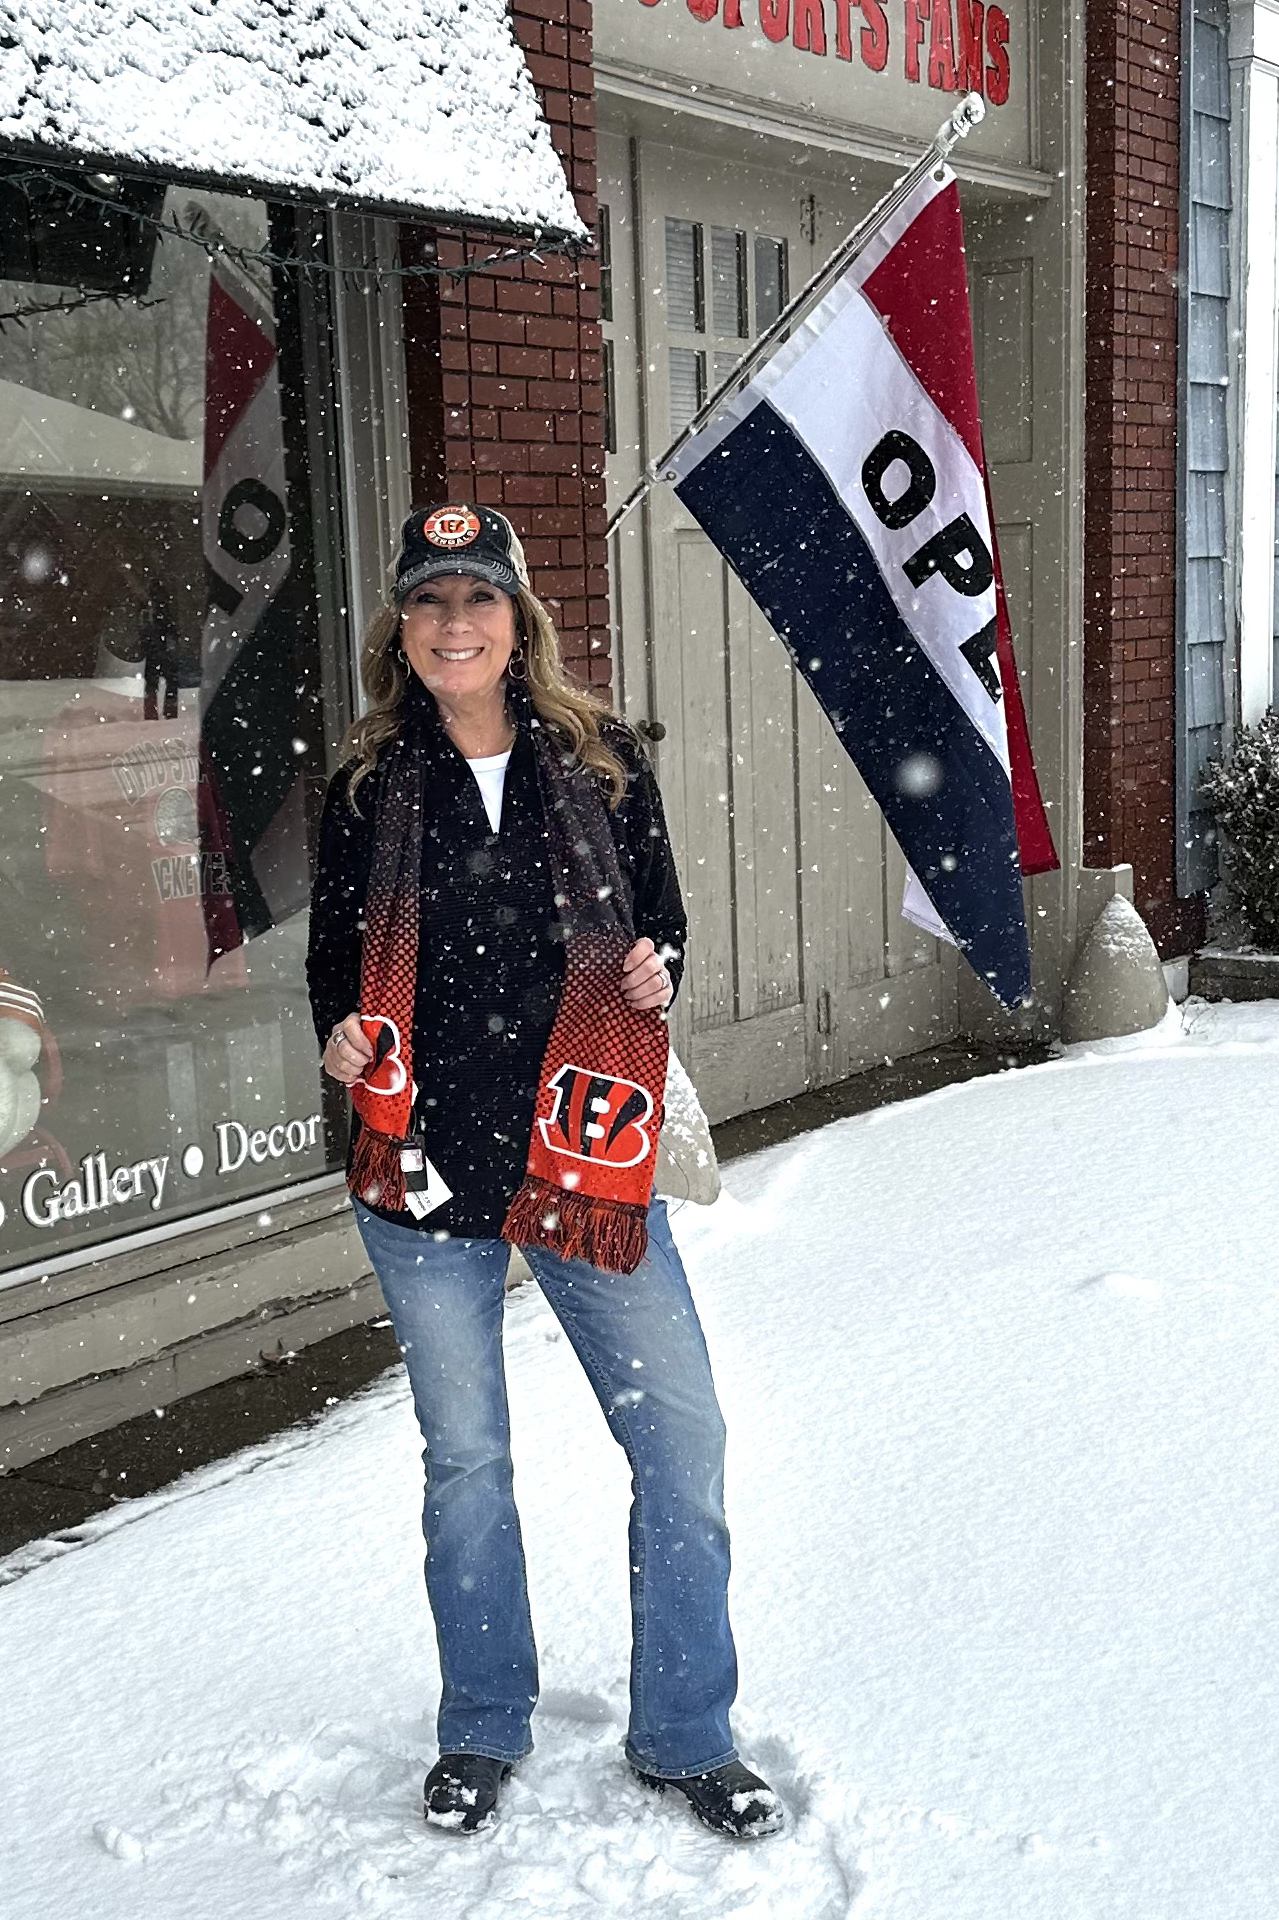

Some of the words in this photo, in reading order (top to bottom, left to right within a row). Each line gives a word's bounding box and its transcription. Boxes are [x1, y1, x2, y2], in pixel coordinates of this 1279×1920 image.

[904, 0, 1011, 106] FANS
[22, 1151, 170, 1228] Gallery
[213, 1113, 321, 1175] Decor
